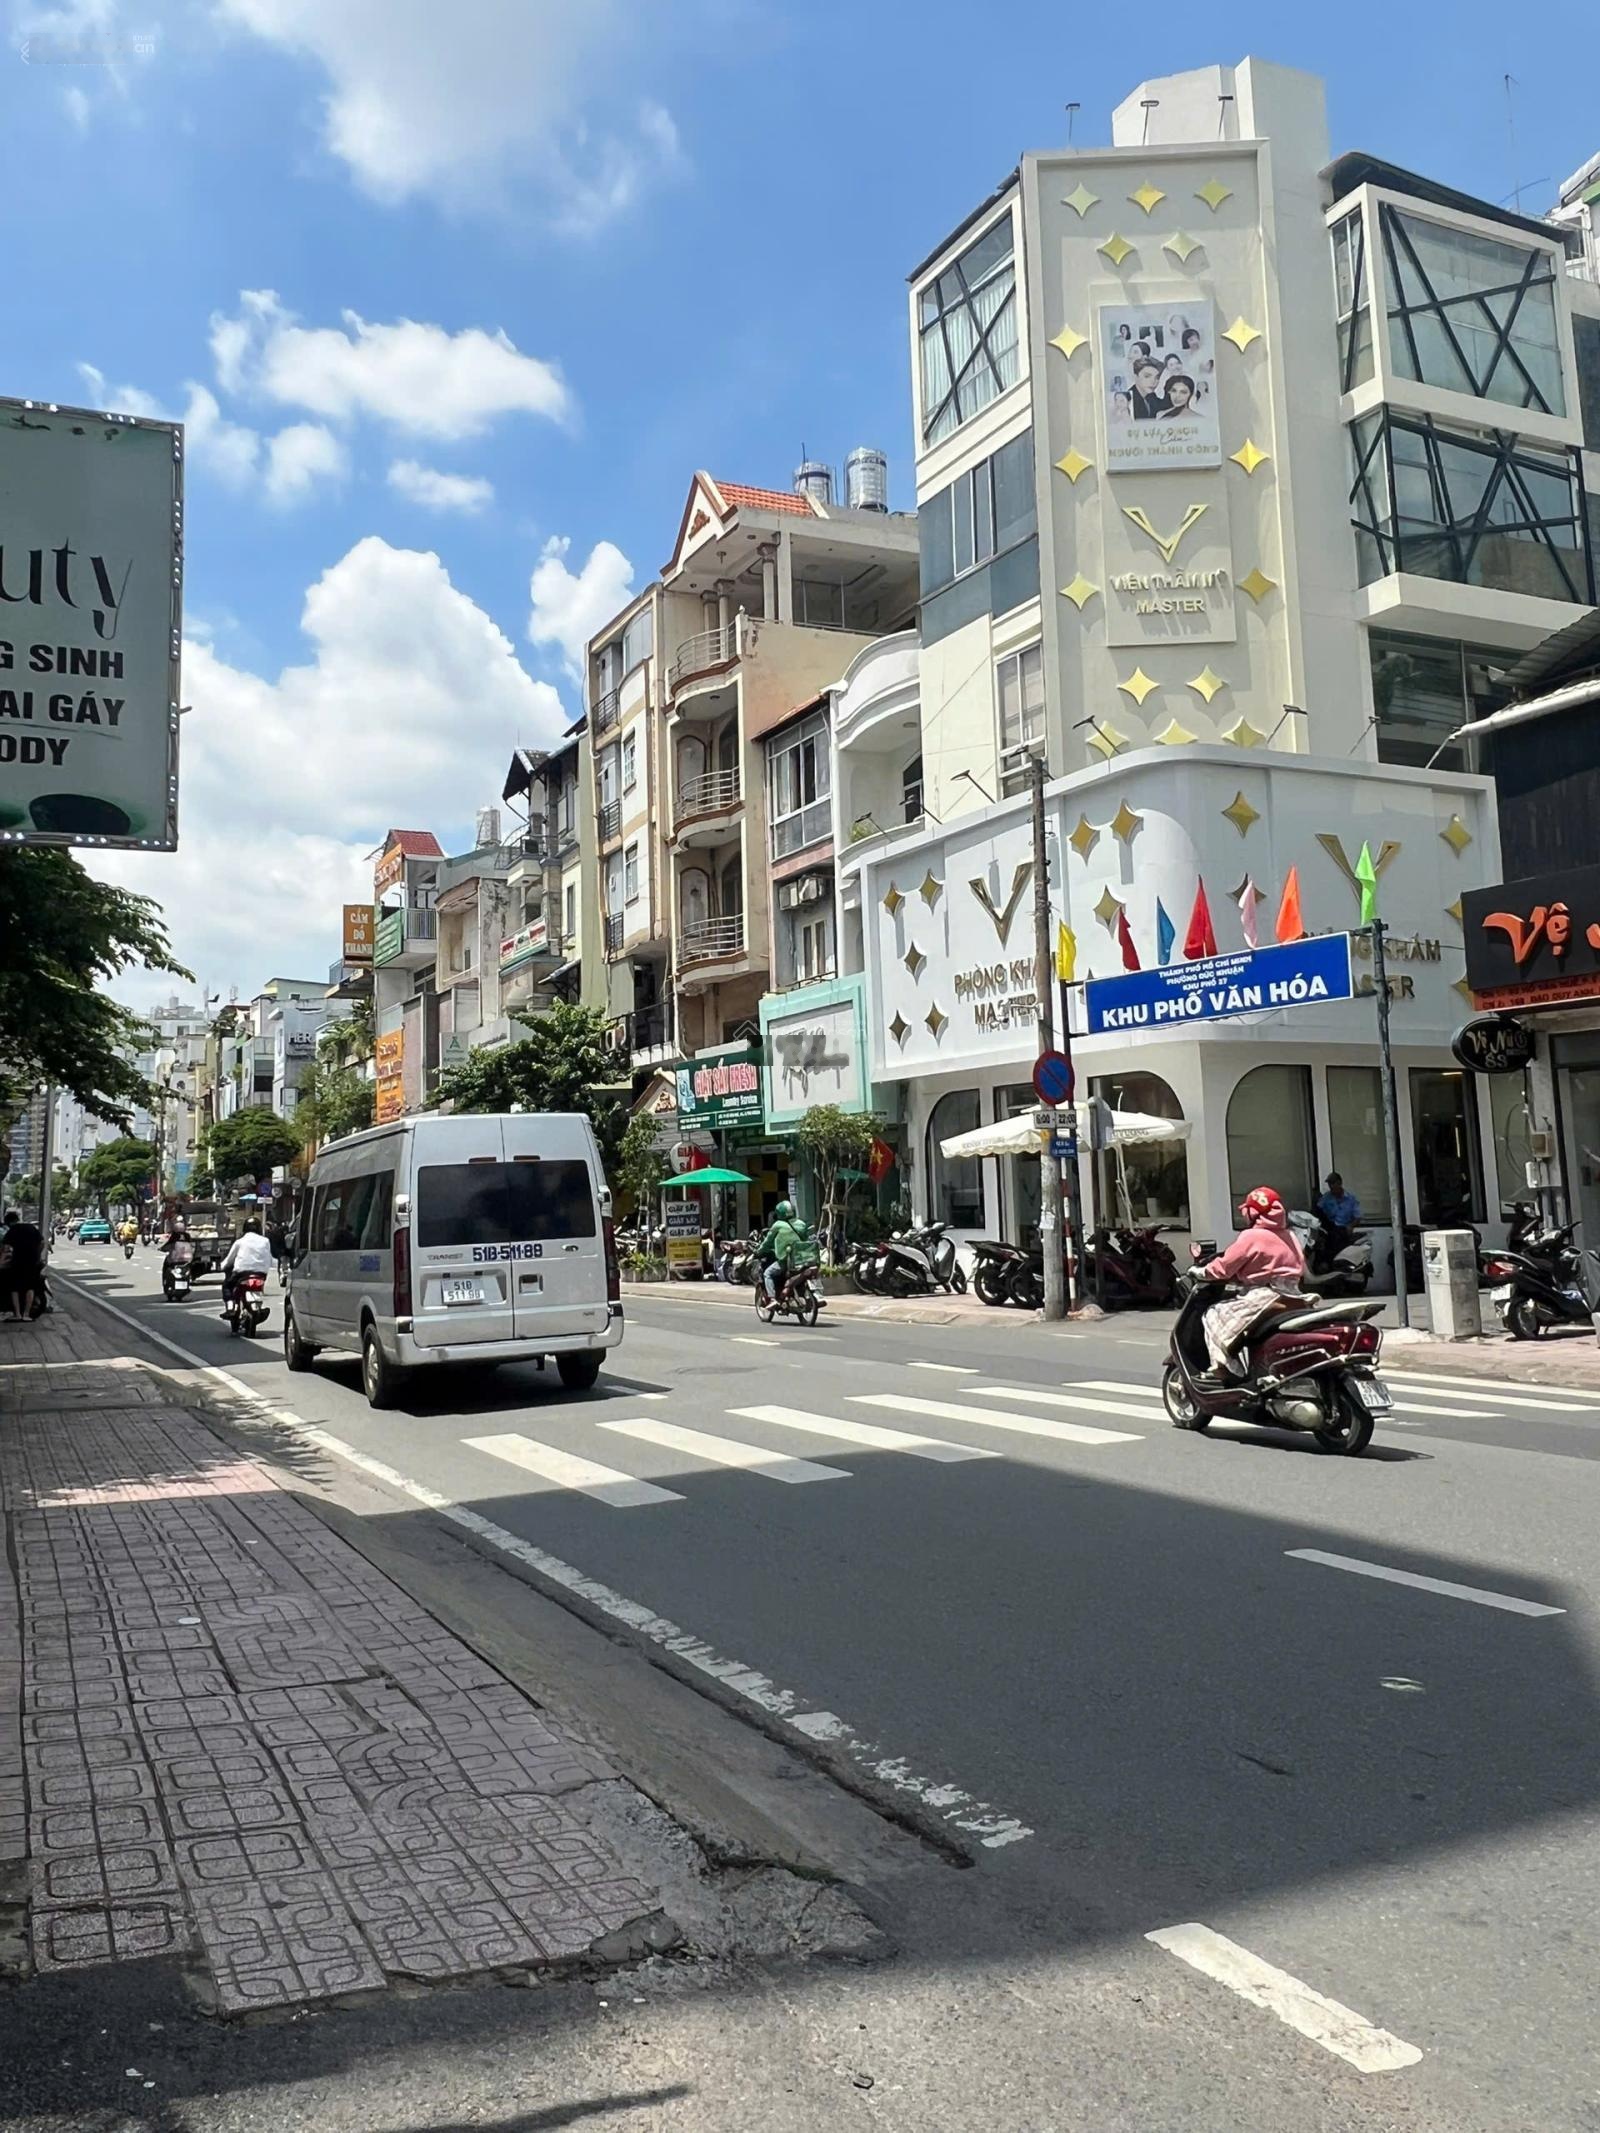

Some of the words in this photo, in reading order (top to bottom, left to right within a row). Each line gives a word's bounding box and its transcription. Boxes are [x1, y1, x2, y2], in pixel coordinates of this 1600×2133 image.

[1136, 599, 1205, 616] MASTER
[29, 644, 124, 679] SINH
[49, 691, 125, 726] GÁY
[1482, 902, 1570, 964] Vệ
[954, 964, 1007, 994] PHÒNG
[1166, 973, 1197, 985] PHƯỜNG
[1216, 966, 1244, 977] NHUẬN
[1185, 962, 1201, 974] PHỐ
[1202, 960, 1214, 971] HỒ
[1215, 958, 1229, 968] CHÍ
[1230, 955, 1252, 965] MINH
[1183, 982, 1199, 990] KHU
[1200, 977, 1216, 987] PHỐ
[1102, 1004, 1149, 1028] KHU
[1154, 989, 1203, 1021] PHỐ
[1209, 985, 1262, 1011] VĂN
[1269, 973, 1328, 1003] HÓA
[729, 1063, 758, 1093] FRESH
[454, 1281, 472, 1290] 51B
